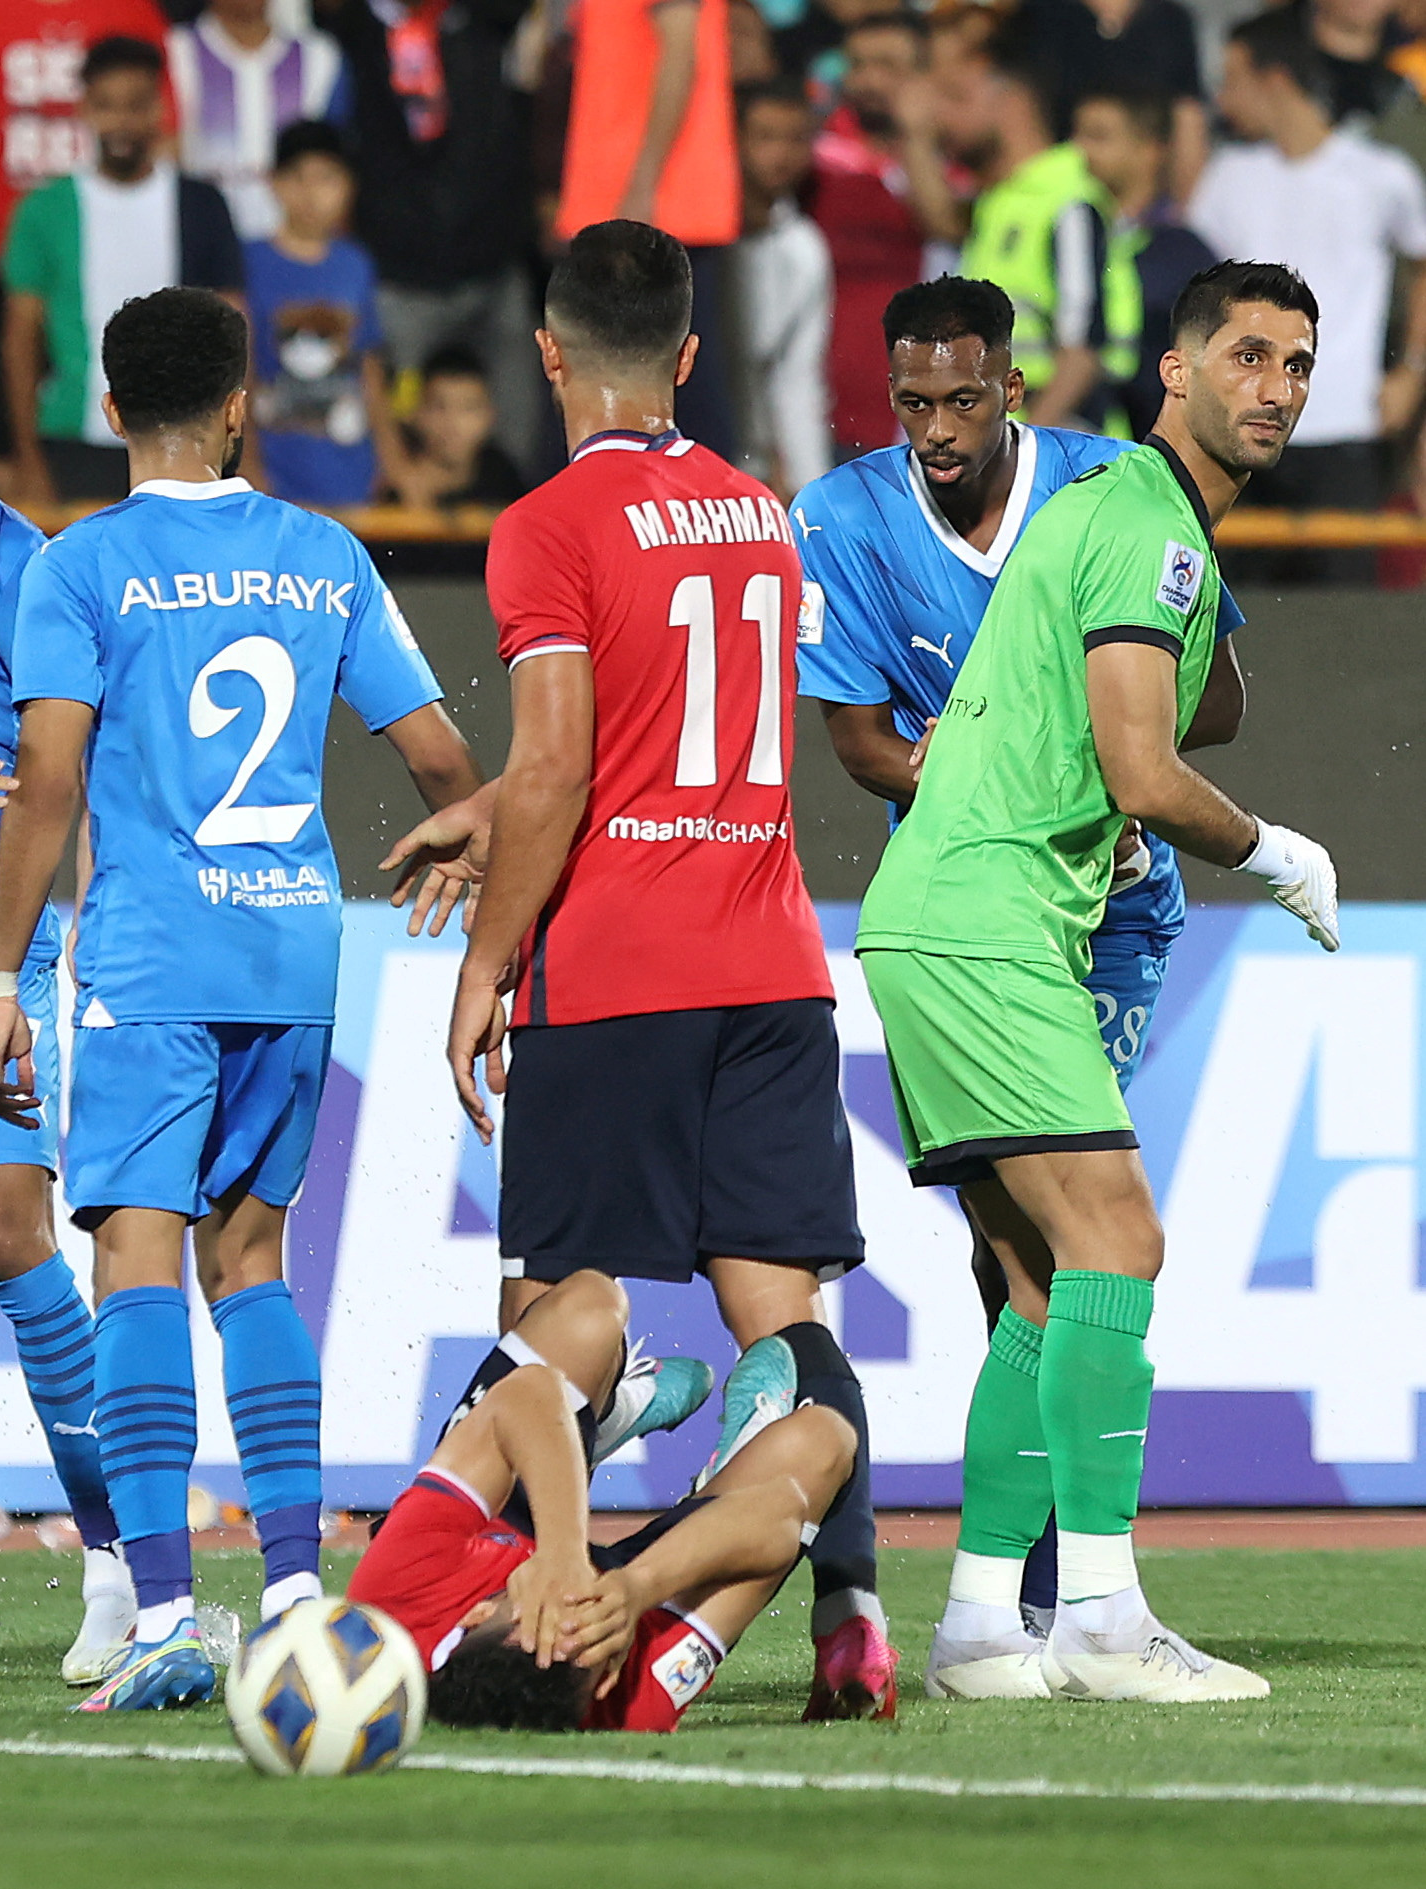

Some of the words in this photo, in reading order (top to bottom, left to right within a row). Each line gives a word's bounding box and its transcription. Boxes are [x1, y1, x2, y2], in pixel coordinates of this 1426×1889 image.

[120, 571, 355, 618] ALBURAYK
[668, 573, 783, 786] 11
[945, 697, 974, 718] ITY
[188, 635, 316, 846] 2
[231, 890, 330, 907] FOUNDATION
